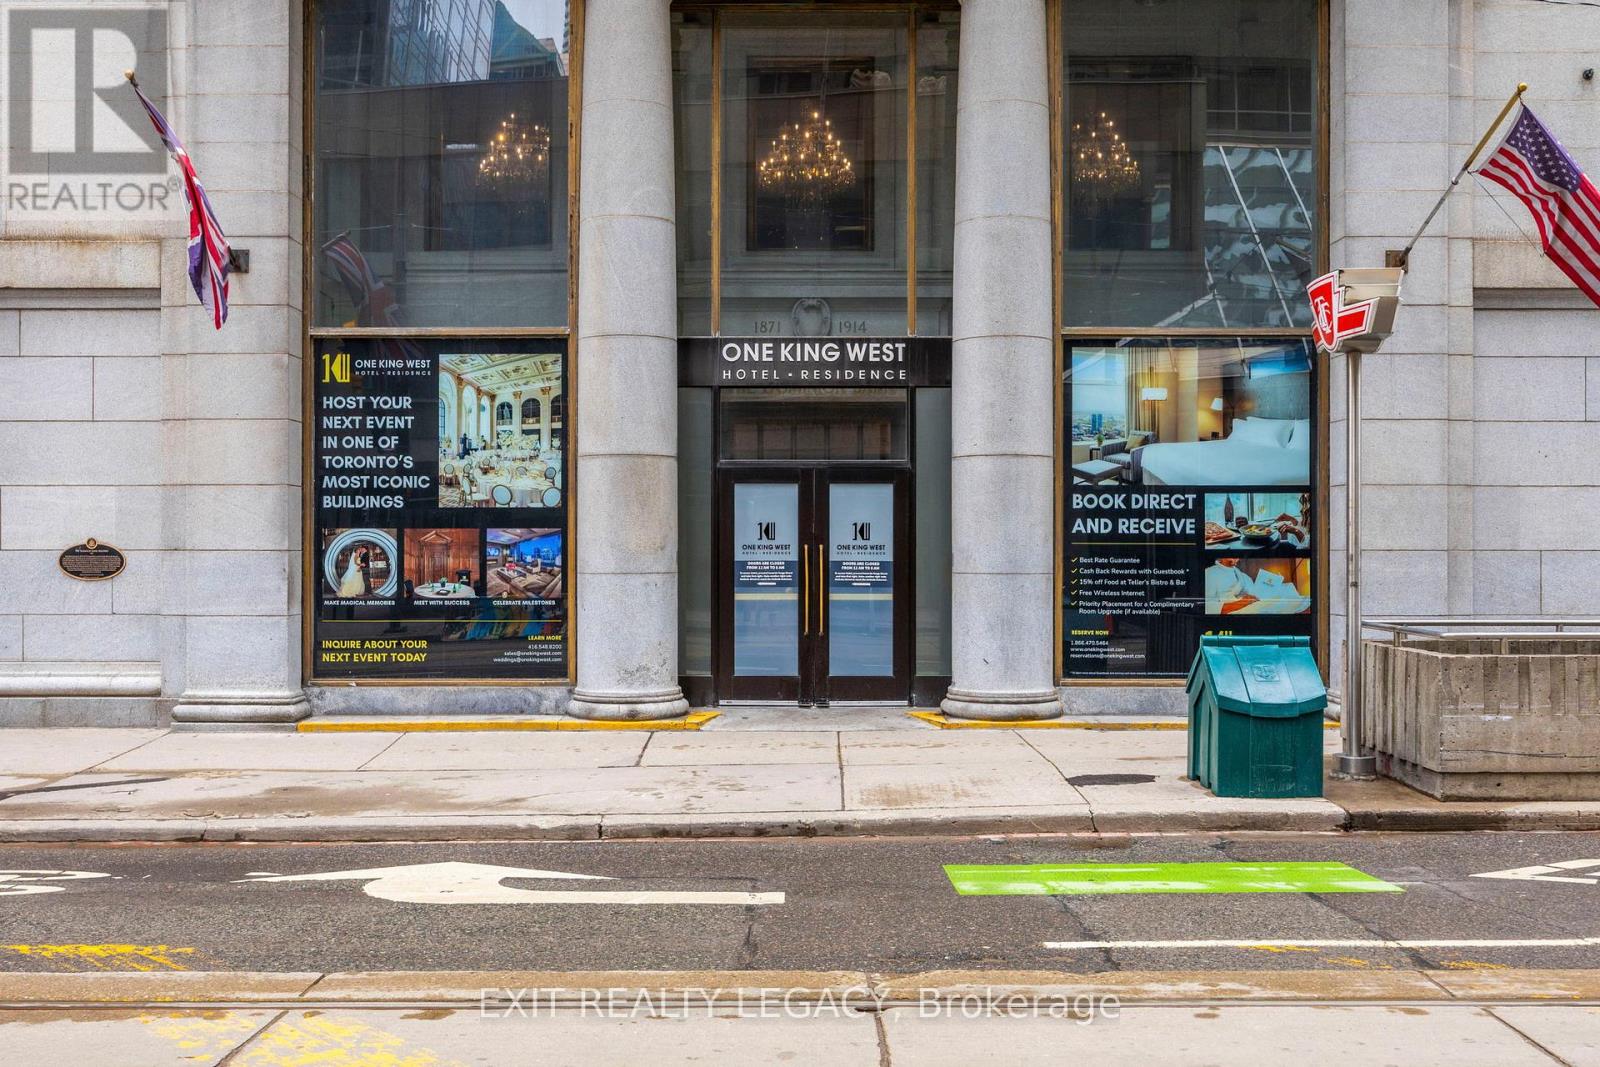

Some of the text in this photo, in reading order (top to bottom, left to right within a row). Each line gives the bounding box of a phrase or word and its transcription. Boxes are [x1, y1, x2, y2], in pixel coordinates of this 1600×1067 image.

[754, 321, 867, 334] 1871 1914
[722, 342, 906, 362] ONE KING WEST
[354, 360, 431, 368] ONE KING WEST
[723, 369, 906, 380] HOTEL RESIDENCE
[322, 396, 412, 409] HOST YOUR
[322, 416, 415, 429] NEXT EVENT
[323, 436, 399, 448] IN ONE OF
[322, 455, 414, 468] TORONTO'S
[322, 476, 430, 488] MOST ICONIC
[323, 495, 404, 508] BUILDINGS
[1072, 494, 1196, 509] BOOK DIRECT
[1071, 518, 1196, 534] AND RECEIVE
[322, 640, 428, 649] INQUIRE ABOUT YOUR
[322, 653, 427, 662] NEXT EVENT TODAY
